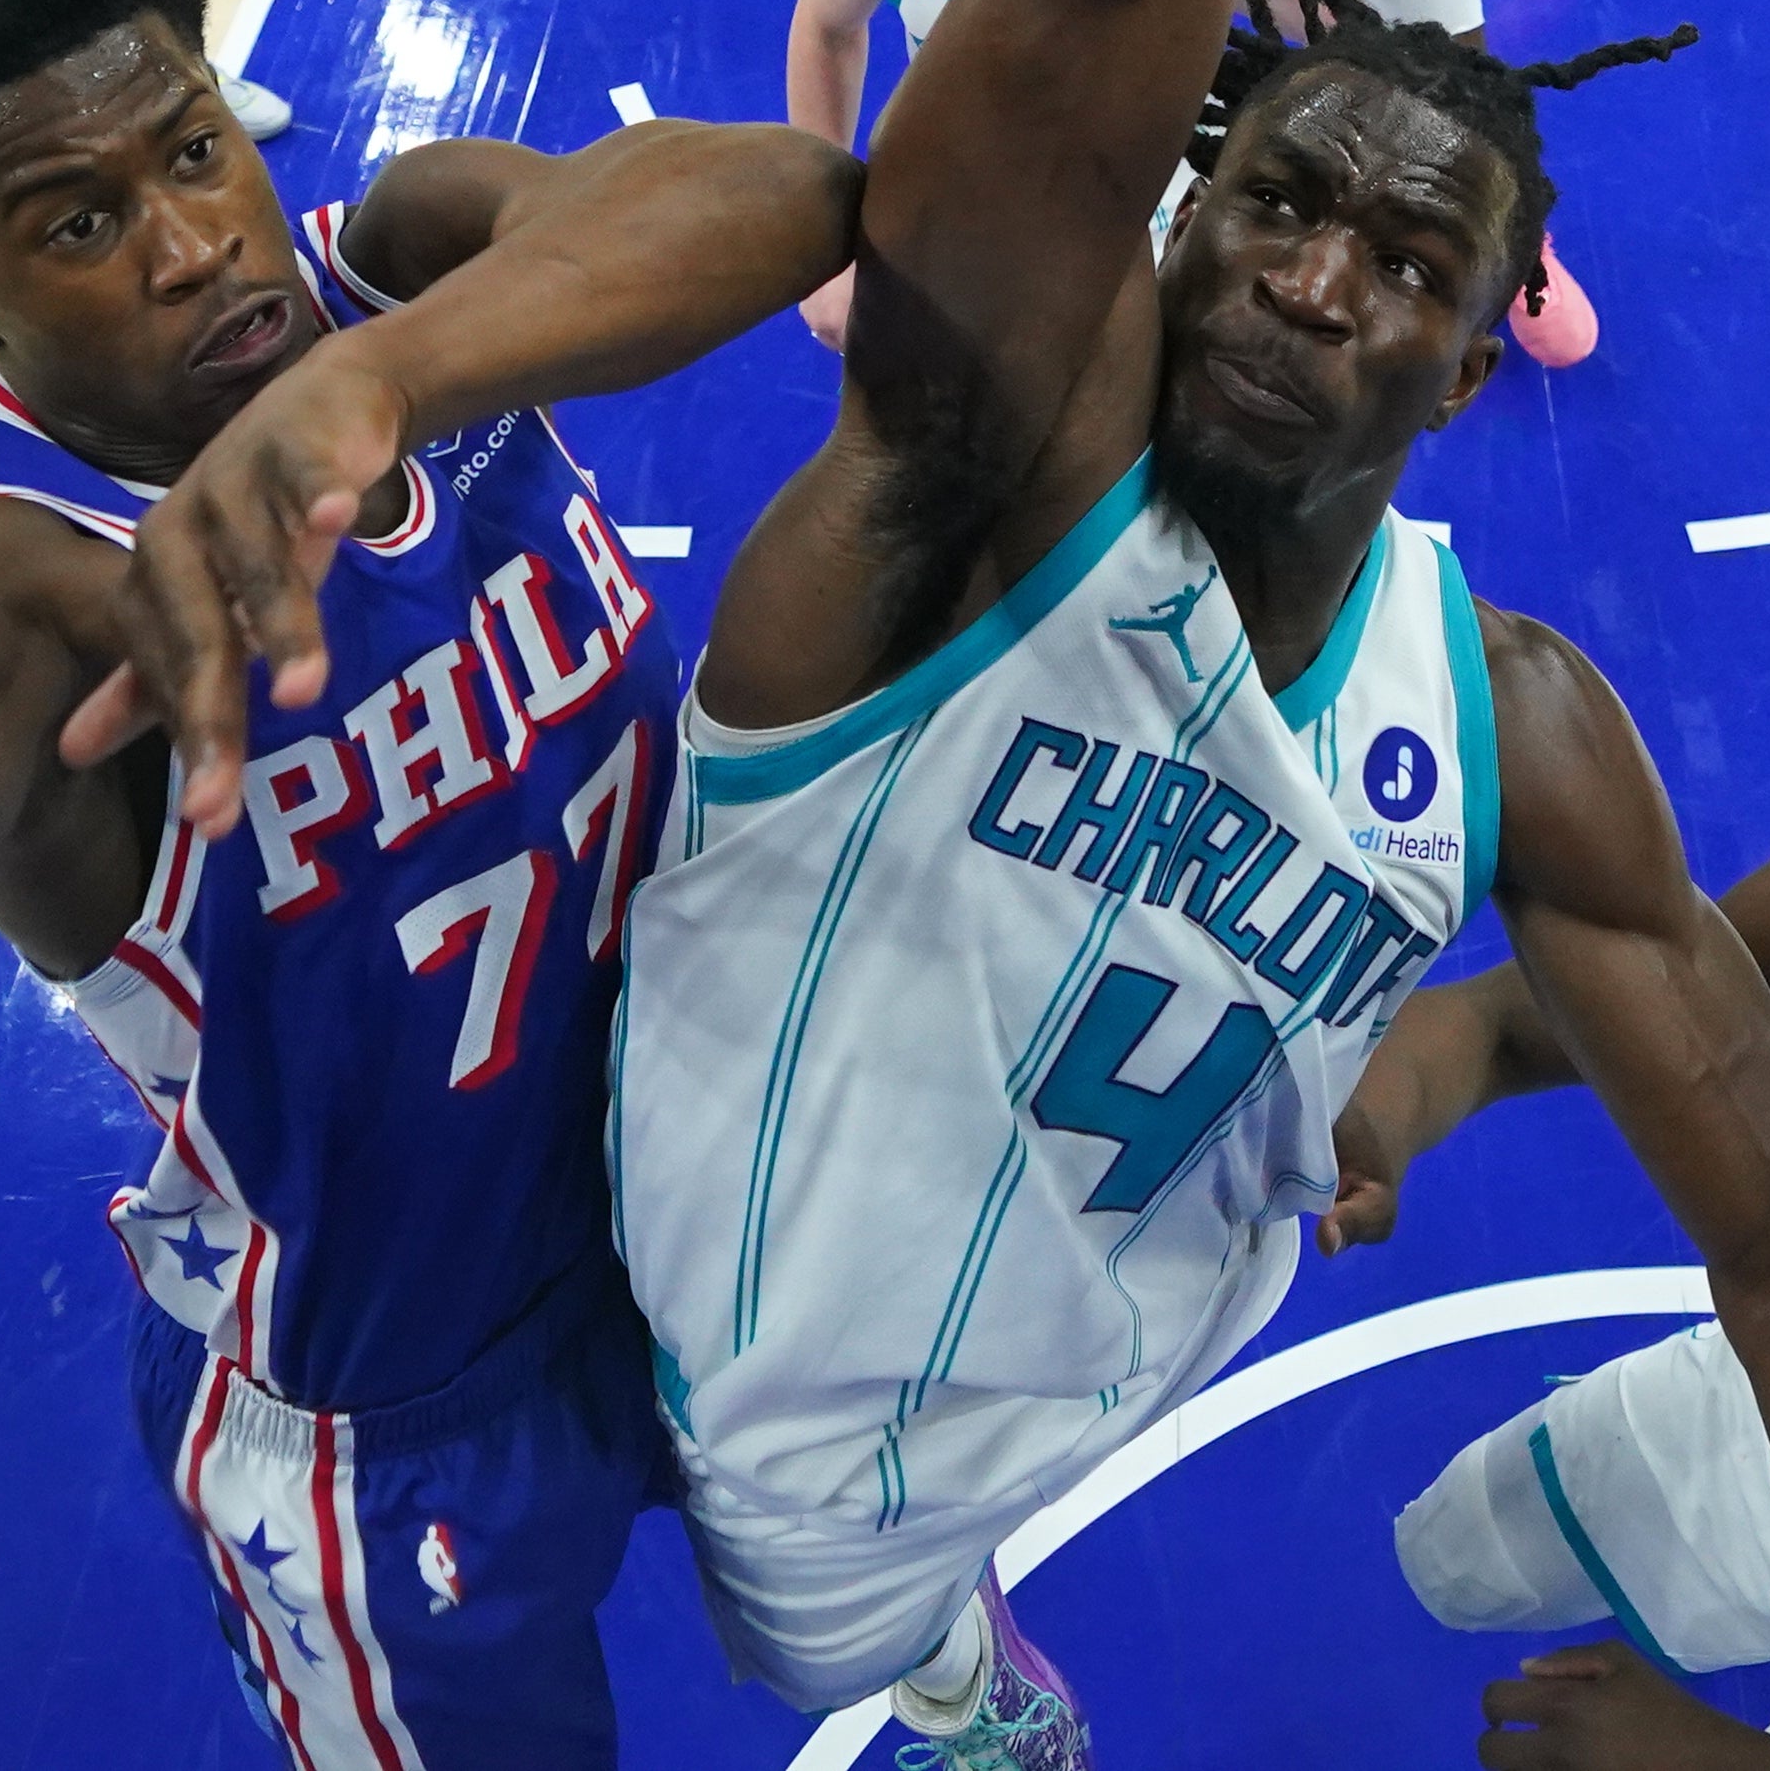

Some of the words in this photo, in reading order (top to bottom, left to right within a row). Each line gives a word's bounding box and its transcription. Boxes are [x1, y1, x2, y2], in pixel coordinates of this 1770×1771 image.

[239, 493, 654, 925] PHILA
[1386, 829, 1460, 864] Health
[394, 719, 650, 1092] 77
[1029, 962, 1283, 1214] 4
